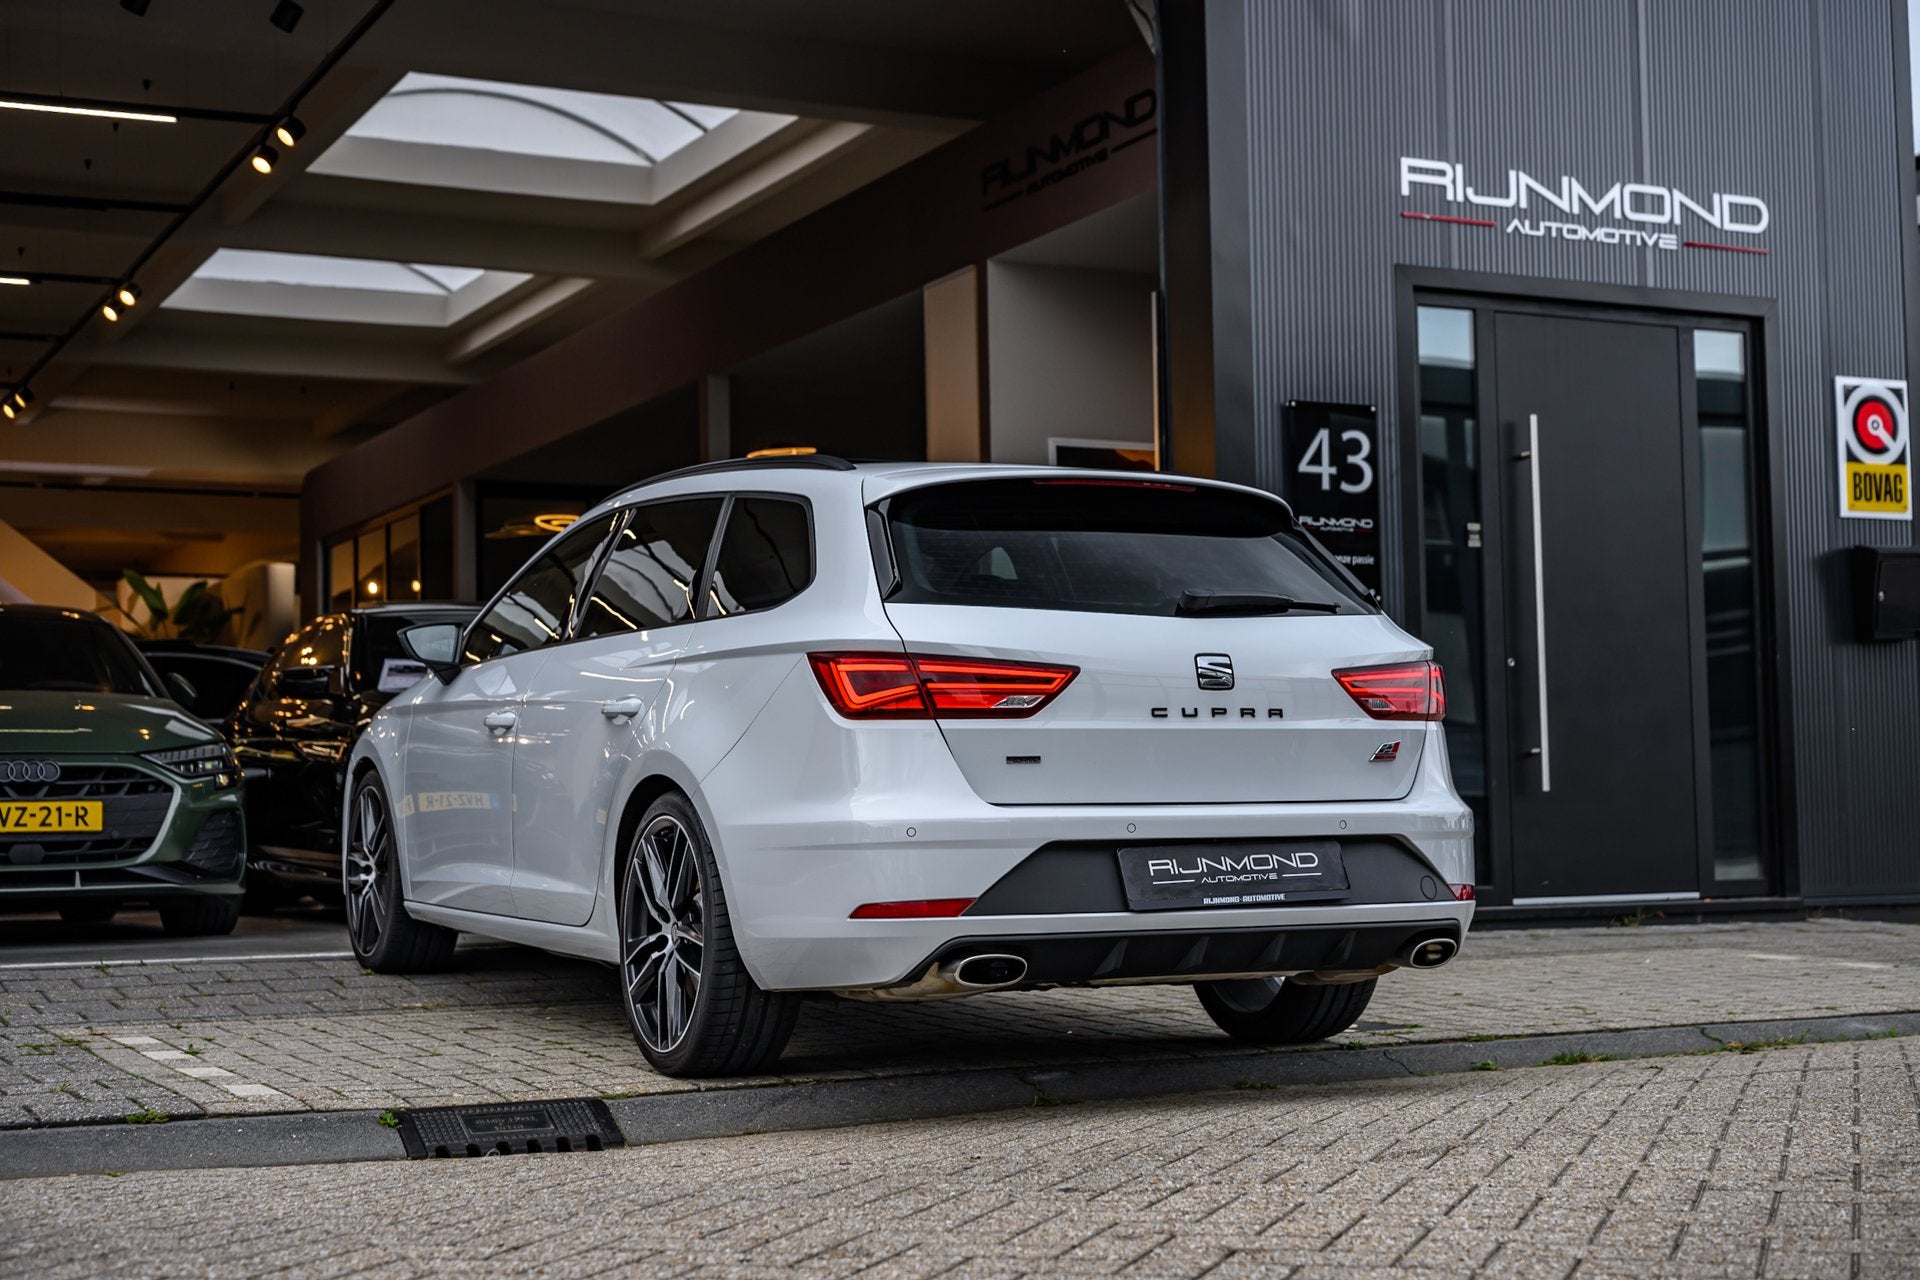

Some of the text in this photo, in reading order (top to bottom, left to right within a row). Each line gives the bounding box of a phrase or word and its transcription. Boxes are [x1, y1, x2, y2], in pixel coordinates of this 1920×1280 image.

[1400, 156, 1770, 234] RIJNMOND
[1506, 218, 1679, 250] AUTOMOTIVE
[1298, 428, 1374, 494] 43
[1853, 471, 1904, 504] BOVAG
[1151, 707, 1283, 719] CUPRA
[1148, 852, 1320, 877] RIJNMOND
[1201, 872, 1279, 884] AUTOMOTIVE
